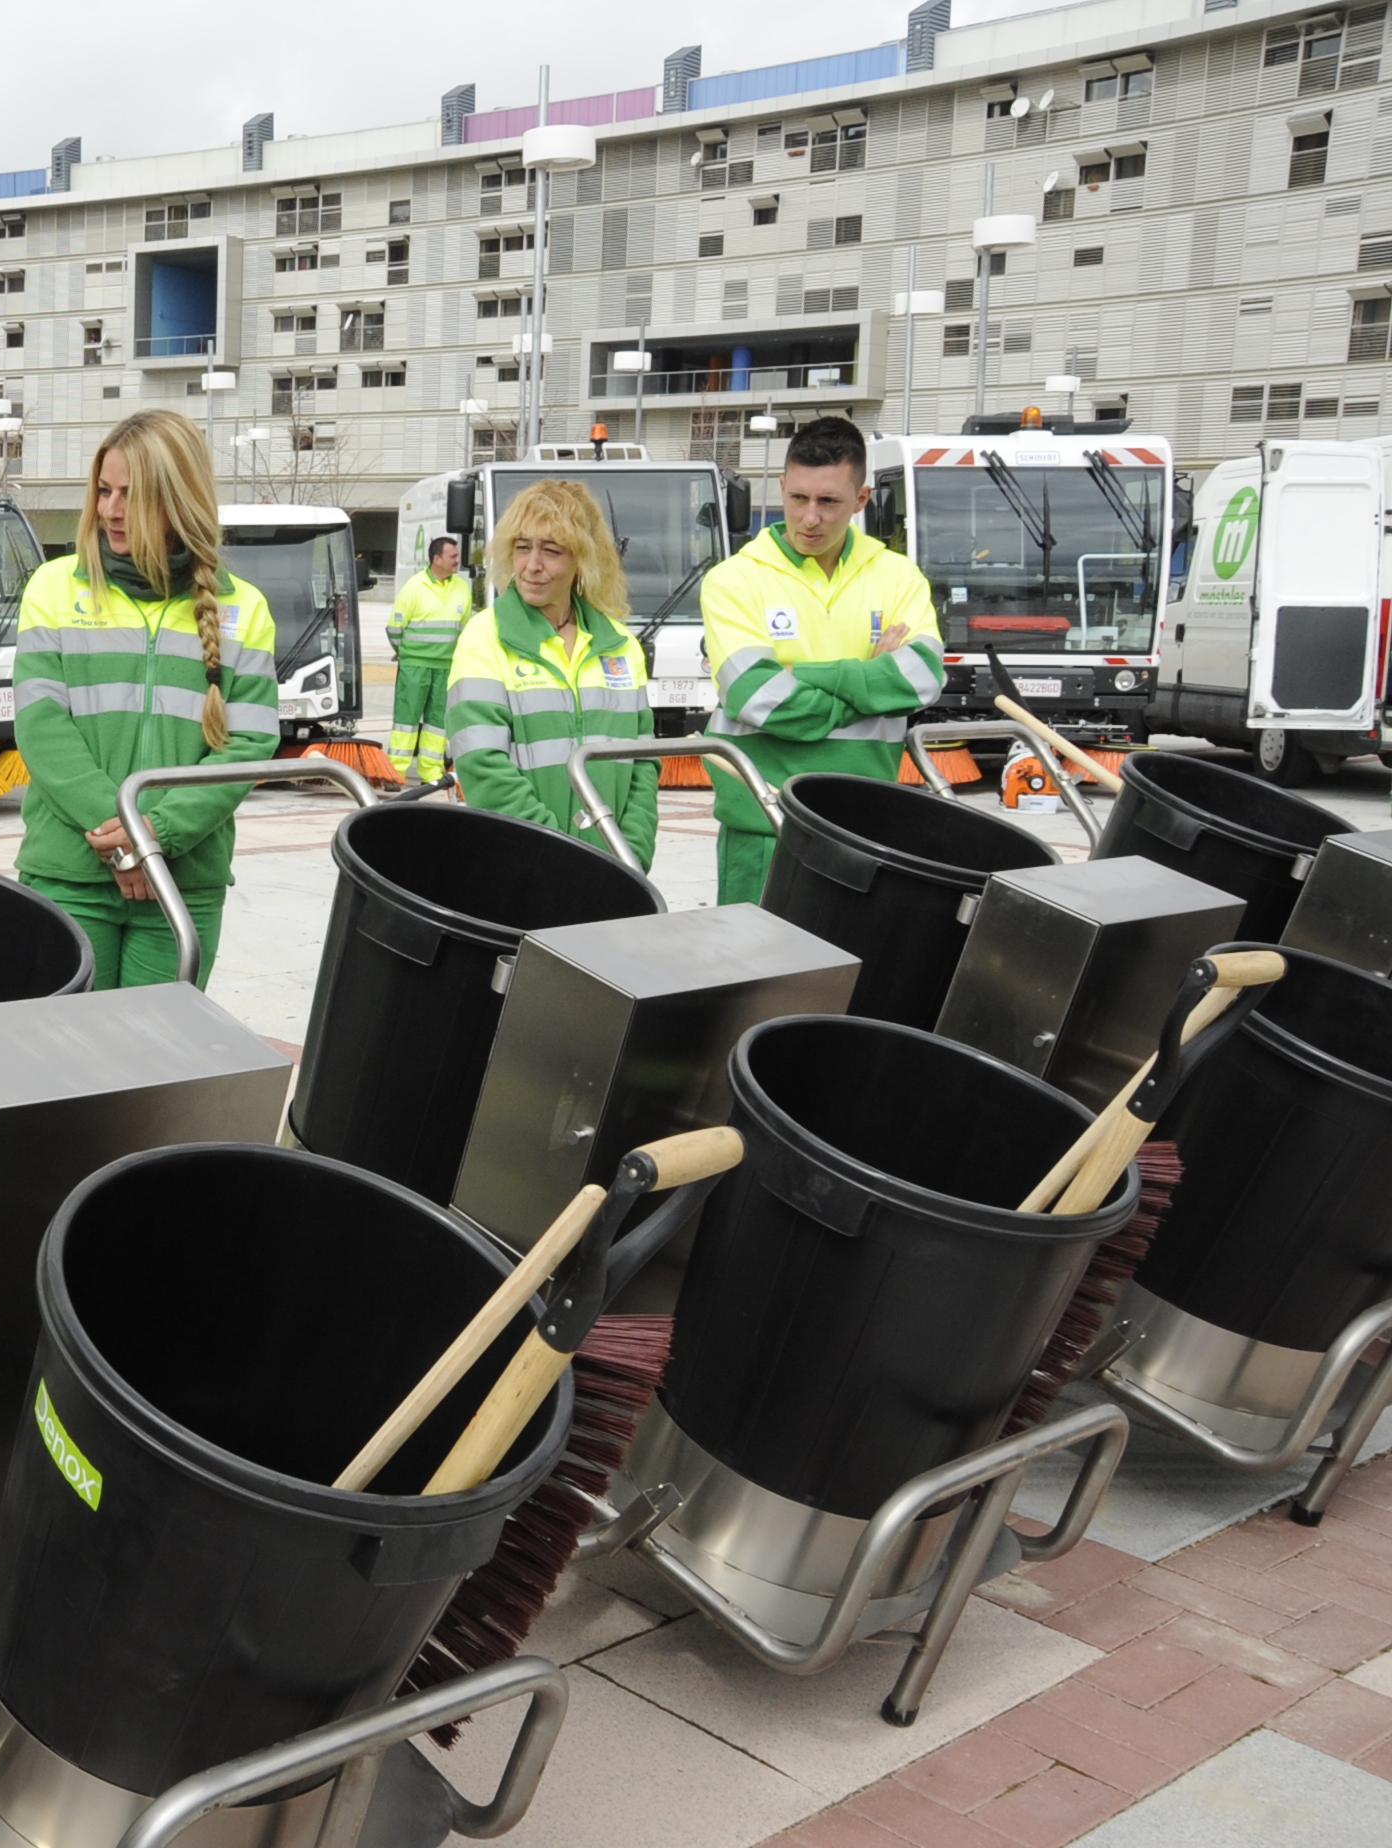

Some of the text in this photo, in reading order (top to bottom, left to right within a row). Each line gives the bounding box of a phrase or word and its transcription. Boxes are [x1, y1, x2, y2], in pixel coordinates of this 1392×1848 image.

[1019, 454, 1057, 462] SCHMIDT
[673, 680, 695, 691] 1873
[1015, 682, 1060, 693] 8422BGD
